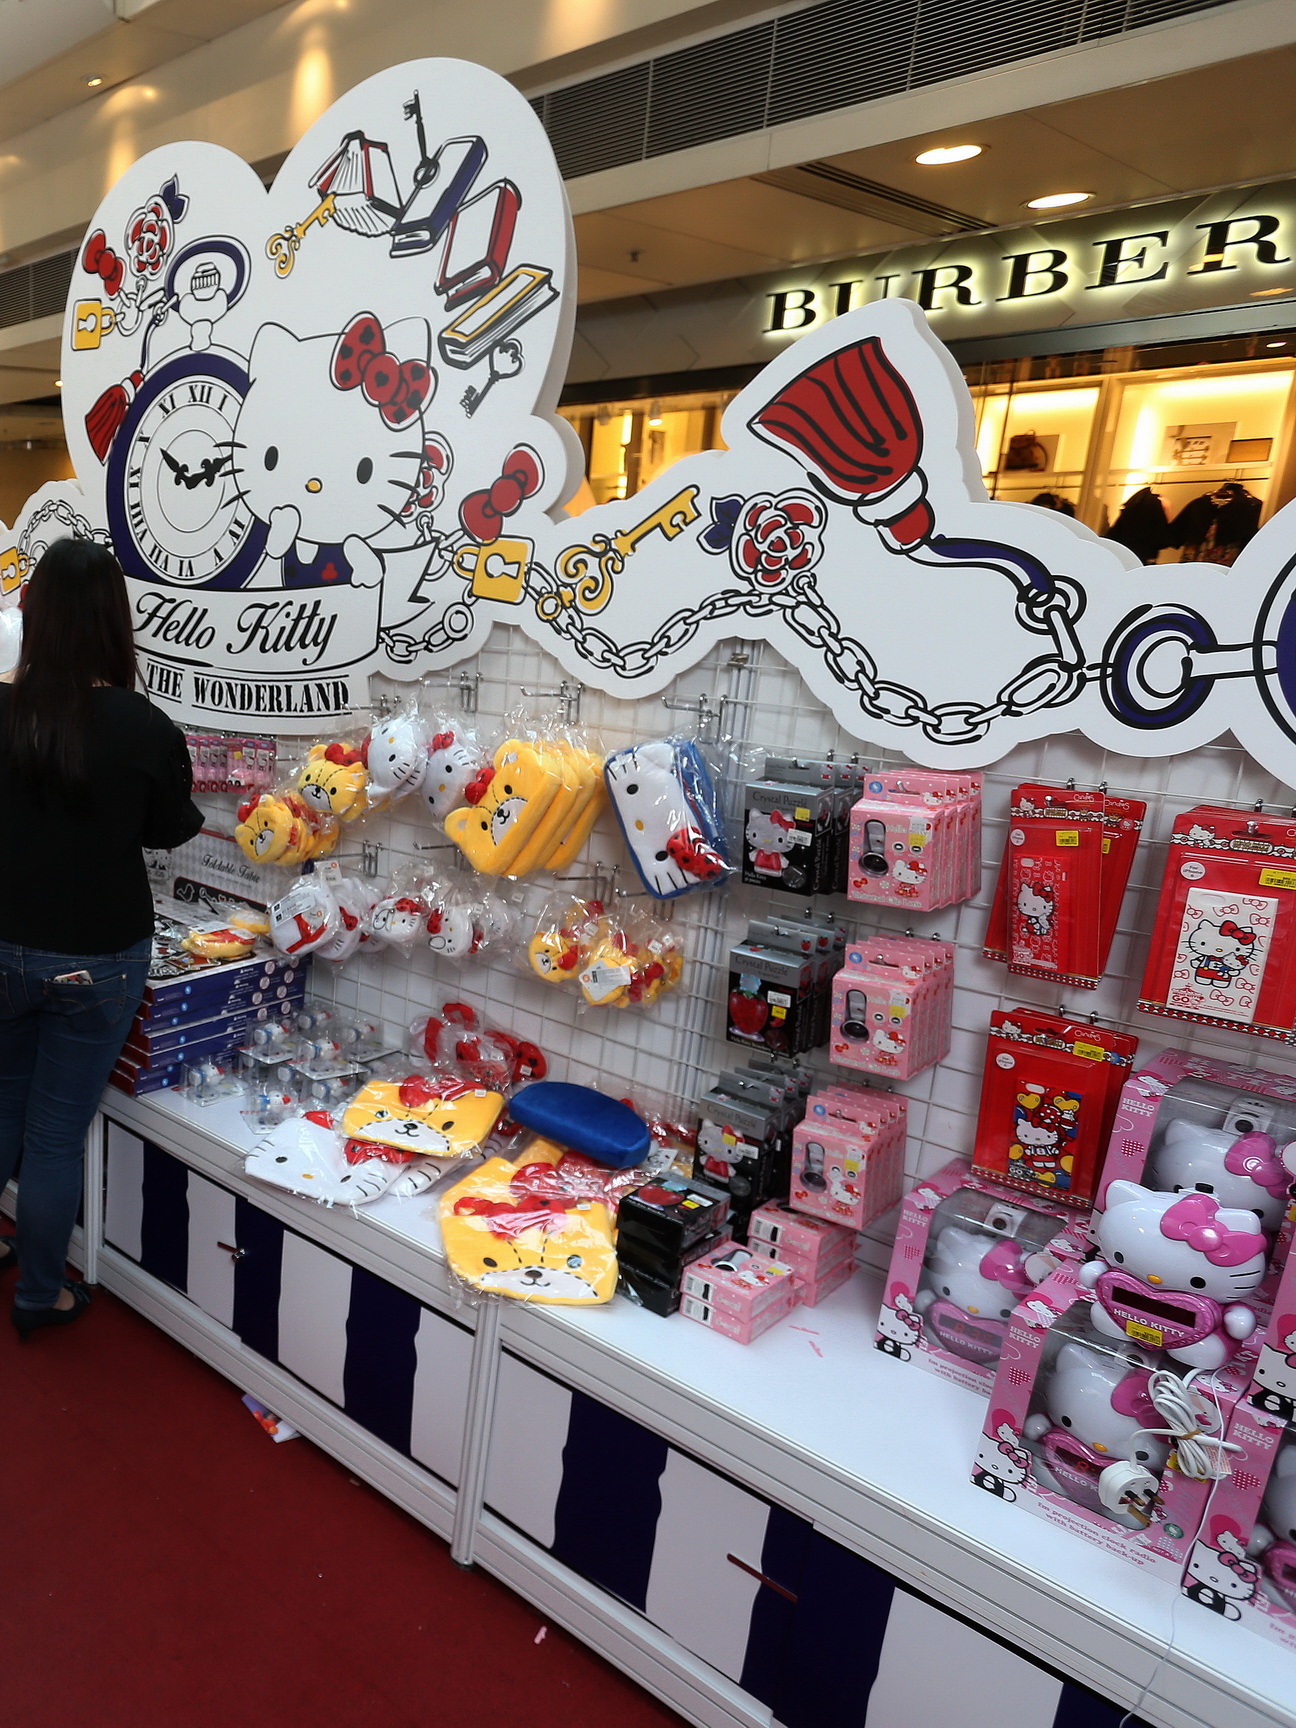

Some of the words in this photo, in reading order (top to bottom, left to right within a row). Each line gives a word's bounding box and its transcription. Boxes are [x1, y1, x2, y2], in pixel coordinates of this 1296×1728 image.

[188, 384, 213, 404] XII
[158, 393, 177, 419] XI
[133, 591, 216, 649] Hello
[226, 599, 338, 666] Kitty
[146, 661, 184, 699] THE
[193, 675, 350, 714] WONDERLAND
[202, 854, 236, 875] Foldable
[238, 864, 261, 883] Table
[1121, 1103, 1154, 1118] KITTY
[1122, 1097, 1155, 1112] HELLO
[902, 1215, 928, 1228] KITTY
[903, 1209, 929, 1222] HELLO
[1113, 1308, 1148, 1326] HELLO
[1150, 1320, 1185, 1338] KITTY
[939, 1331, 965, 1345] HELLO
[1009, 1332, 1040, 1349] KITTY
[1010, 1325, 1041, 1343] HELLO
[1232, 1430, 1272, 1450] KITTY
[1234, 1422, 1275, 1445] HELLO
[1055, 1466, 1088, 1487] HELLO
[1046, 1513, 1066, 1526] with
[1068, 1525, 1103, 1545] battery
[1105, 1543, 1145, 1566] back-up
[1052, 1508, 1099, 1536] projection
[1099, 1534, 1127, 1550] clock
[1129, 1546, 1156, 1563] radio
